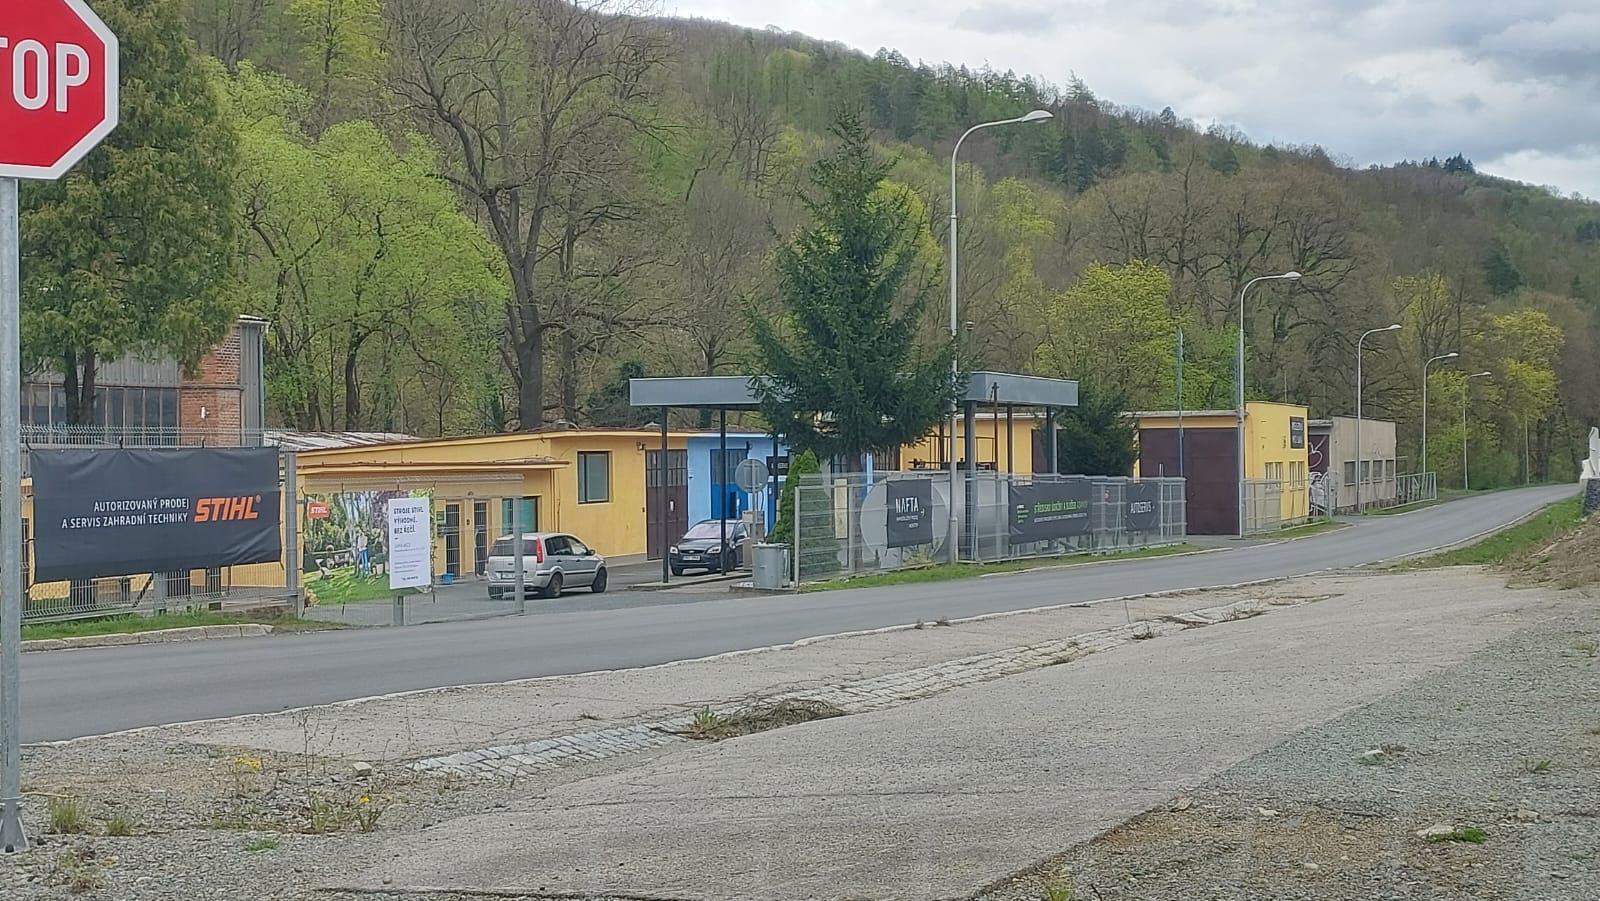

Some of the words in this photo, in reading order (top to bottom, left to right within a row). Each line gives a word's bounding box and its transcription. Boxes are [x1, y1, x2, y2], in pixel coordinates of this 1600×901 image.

[0, 37, 90, 112] OP
[94, 498, 157, 512] AUTORIZOVANÝ
[160, 498, 190, 510] PRODEJ
[194, 496, 259, 522] STIHL
[895, 497, 919, 513] NAFTA
[1130, 501, 1152, 513] AUTOSERVIS
[61, 519, 68, 529] A
[70, 517, 101, 529] SERVIS
[103, 512, 146, 527] ZAHRADNÍ
[148, 513, 188, 525] TECHNIKY
